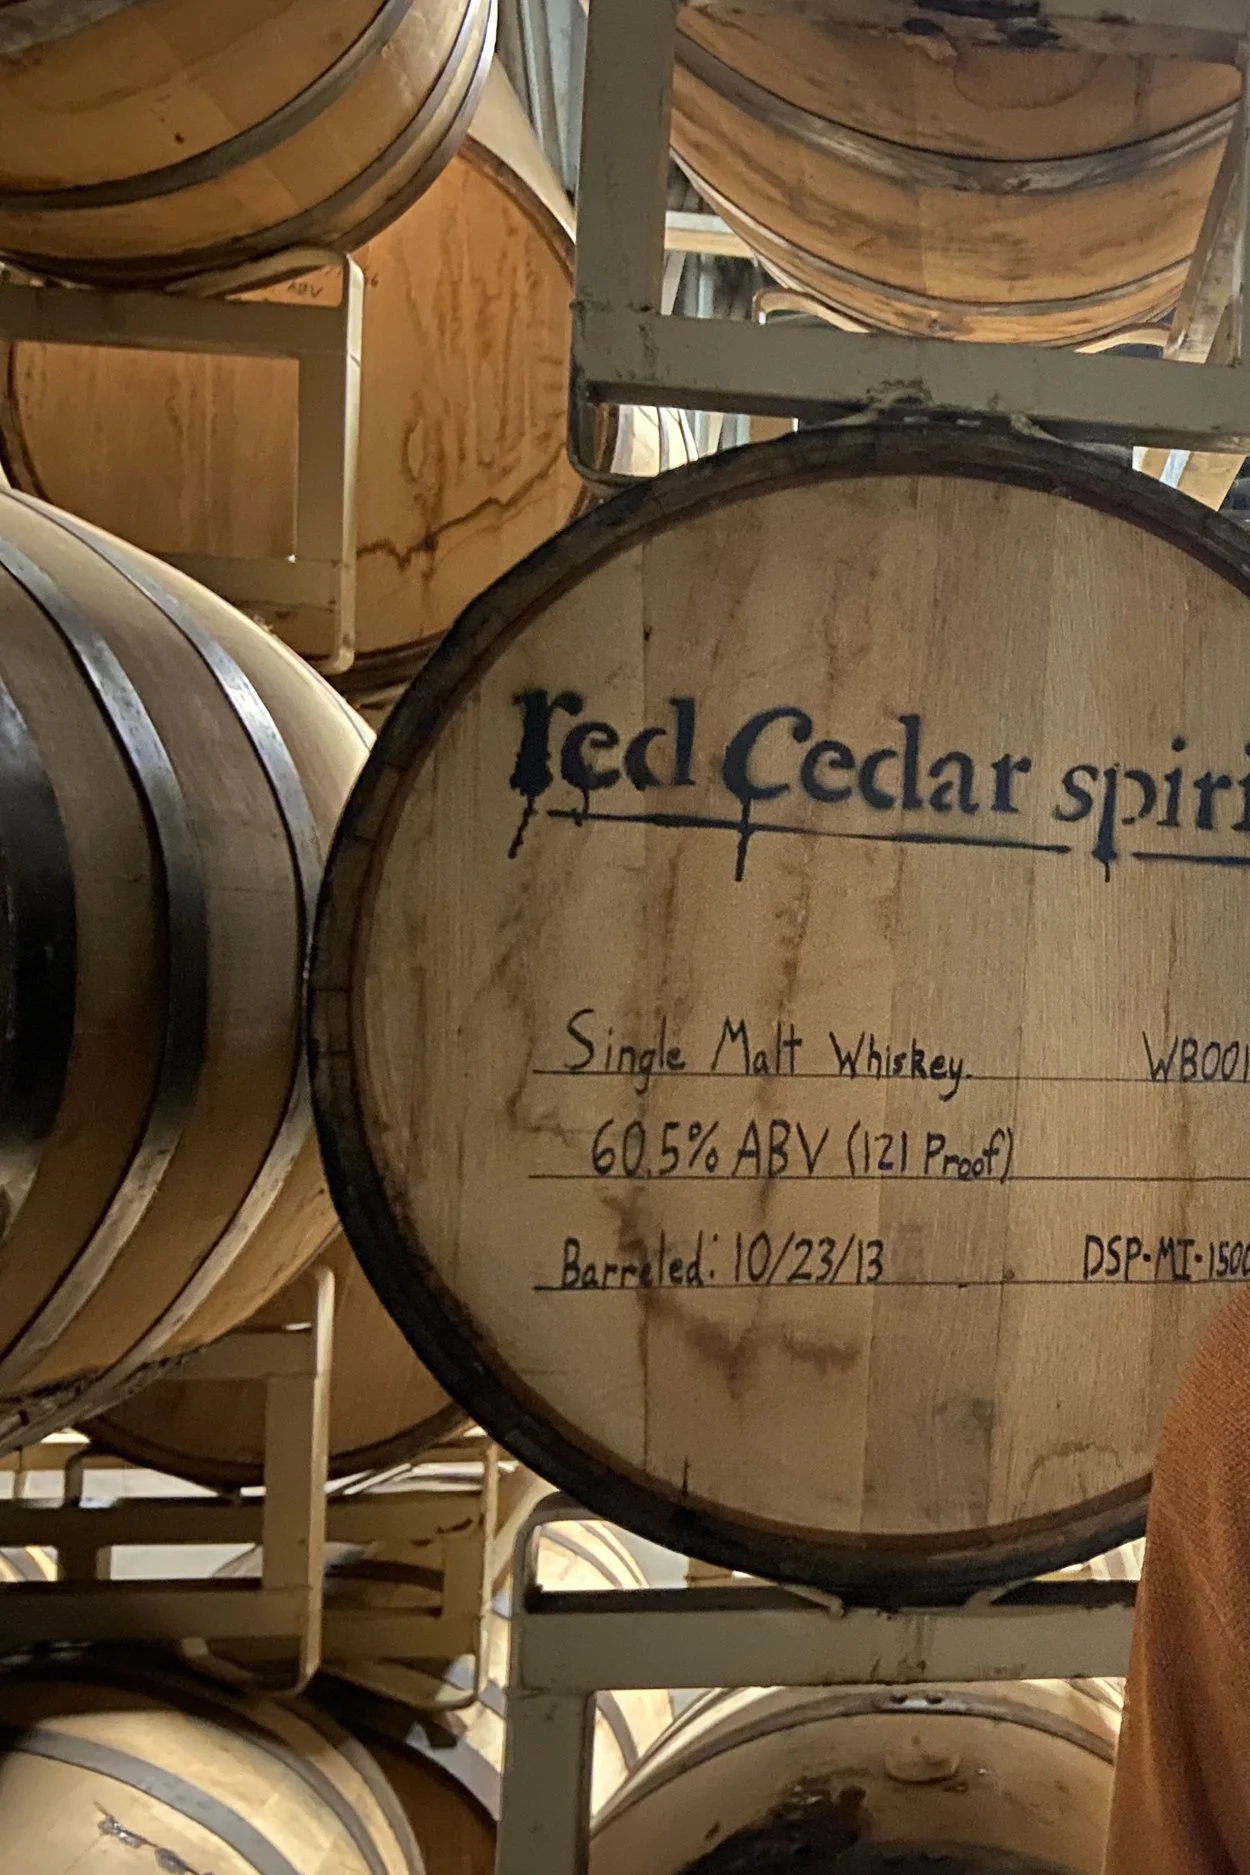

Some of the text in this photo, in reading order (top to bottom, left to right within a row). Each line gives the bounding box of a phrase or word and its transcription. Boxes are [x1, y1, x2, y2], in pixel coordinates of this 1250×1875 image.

[509, 688, 698, 800] red
[722, 706, 1032, 816] Cedar
[564, 1008, 687, 1095] Single
[711, 1015, 803, 1077] Malt
[592, 1118, 1014, 1184] 60.5% ABV (121 Proof)
[735, 1230, 884, 1286] 10/23/13
